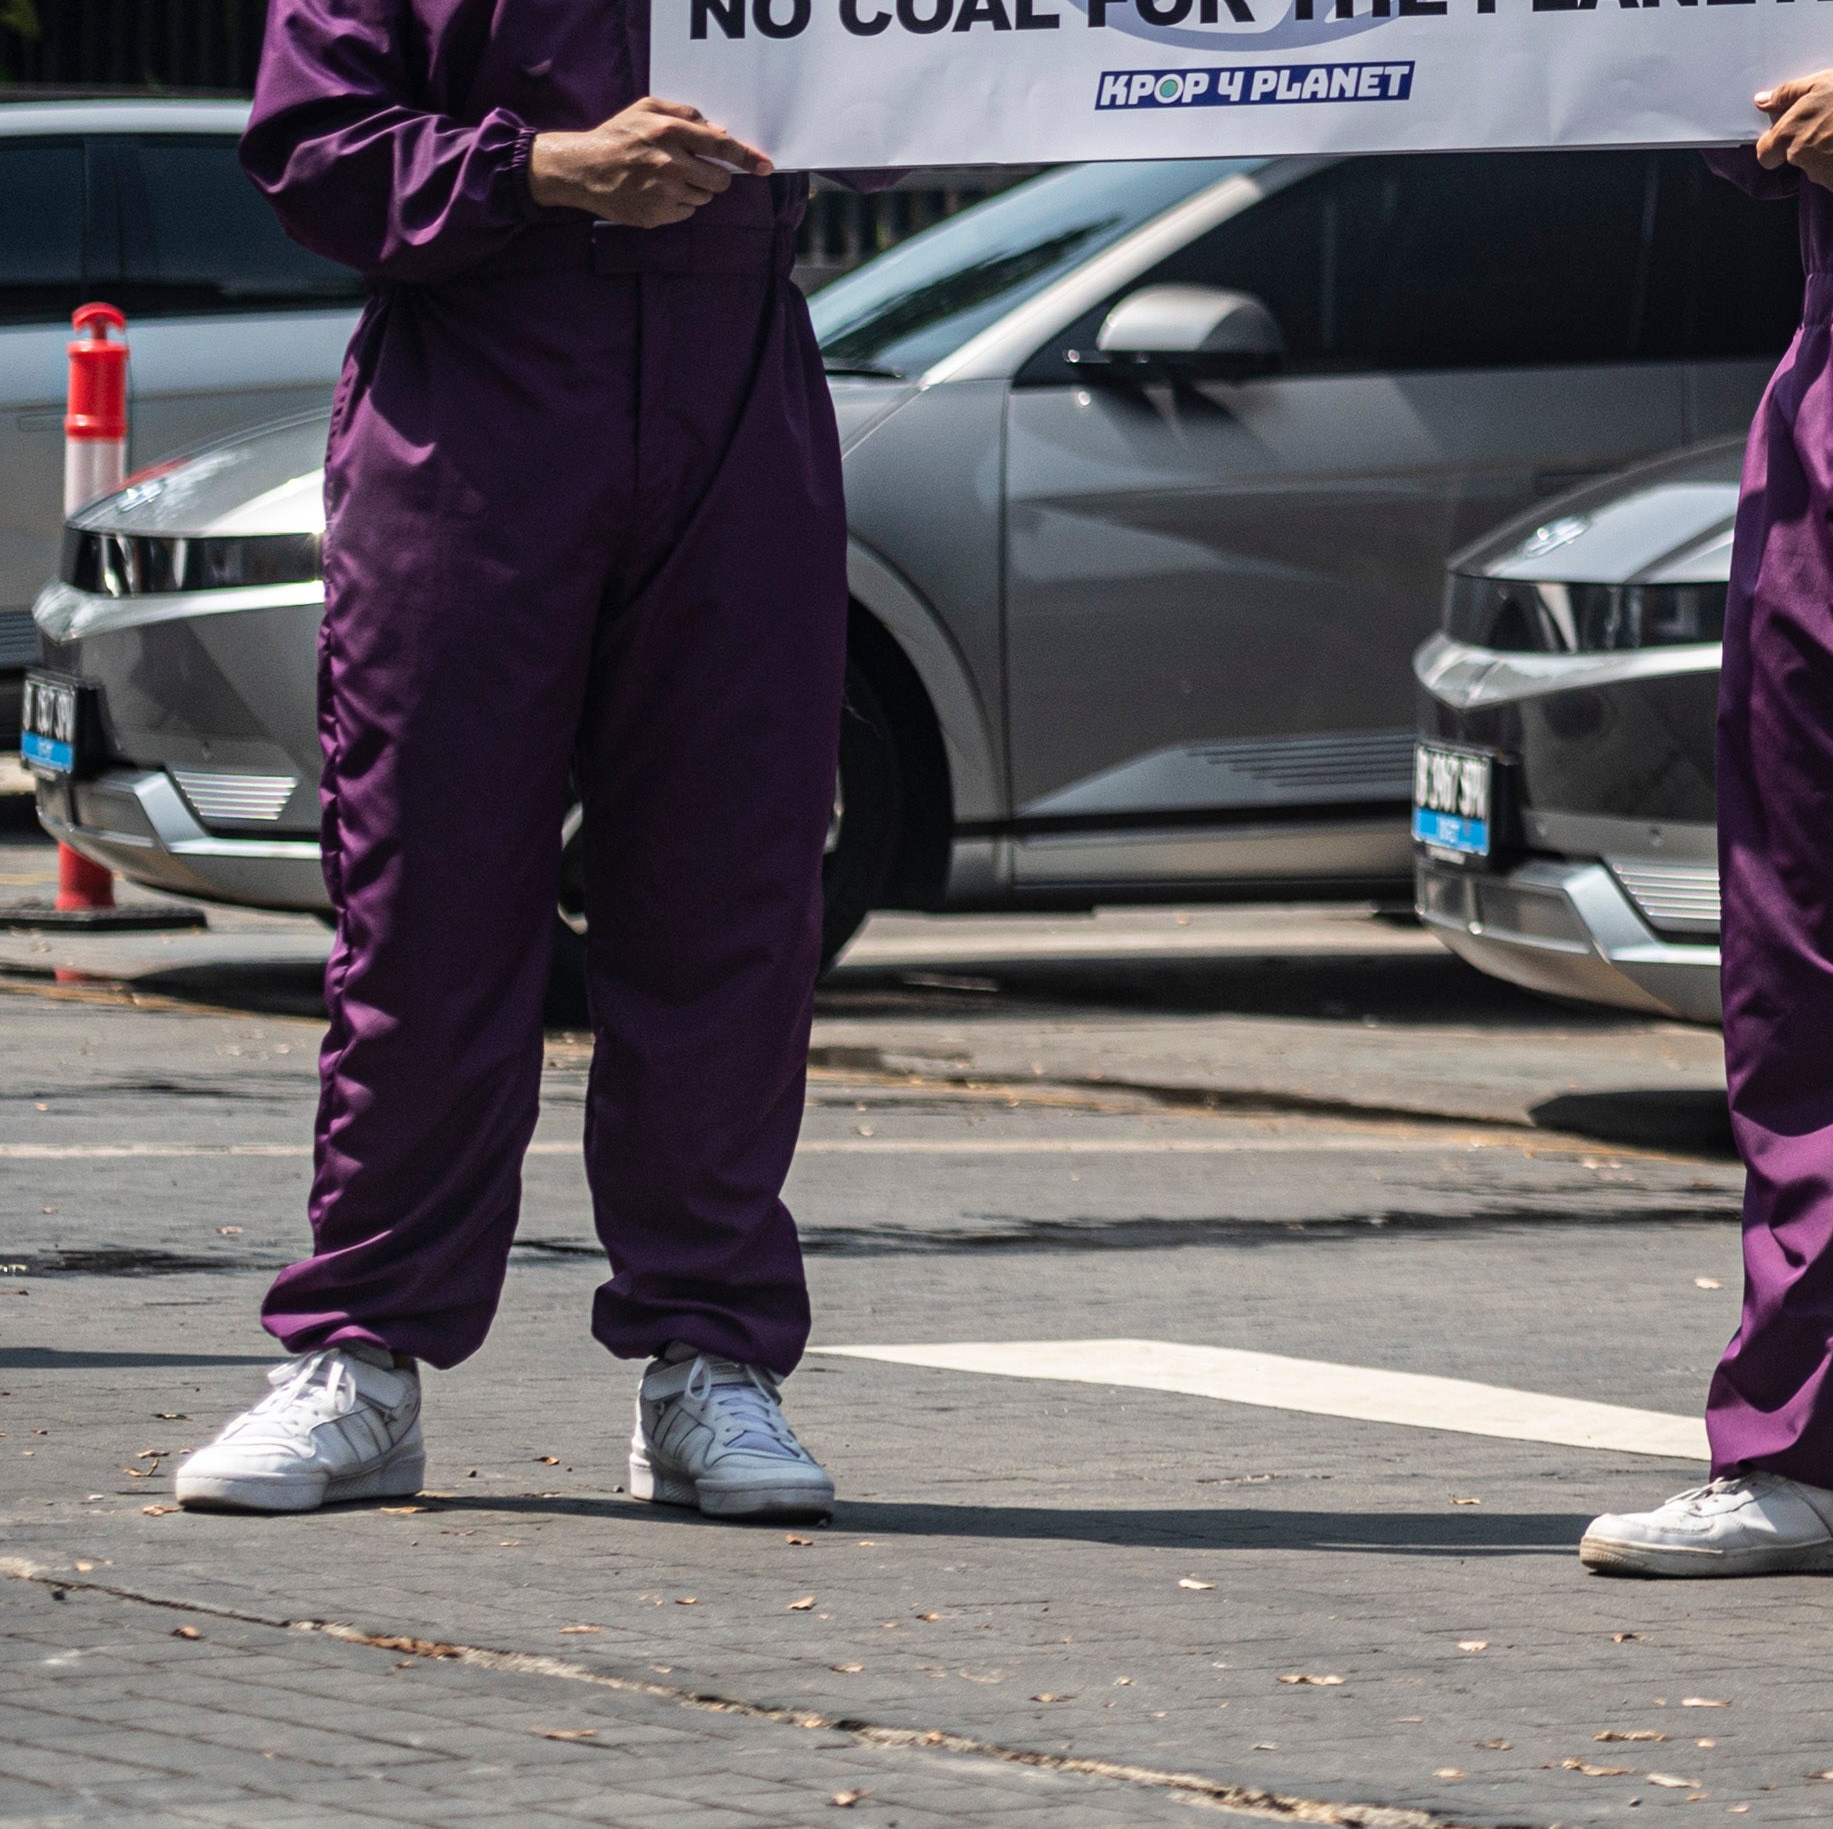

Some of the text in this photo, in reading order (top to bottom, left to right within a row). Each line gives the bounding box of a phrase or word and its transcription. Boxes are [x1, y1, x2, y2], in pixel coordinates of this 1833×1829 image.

[1100, 65, 1410, 106] KPOP 4 PLANET
